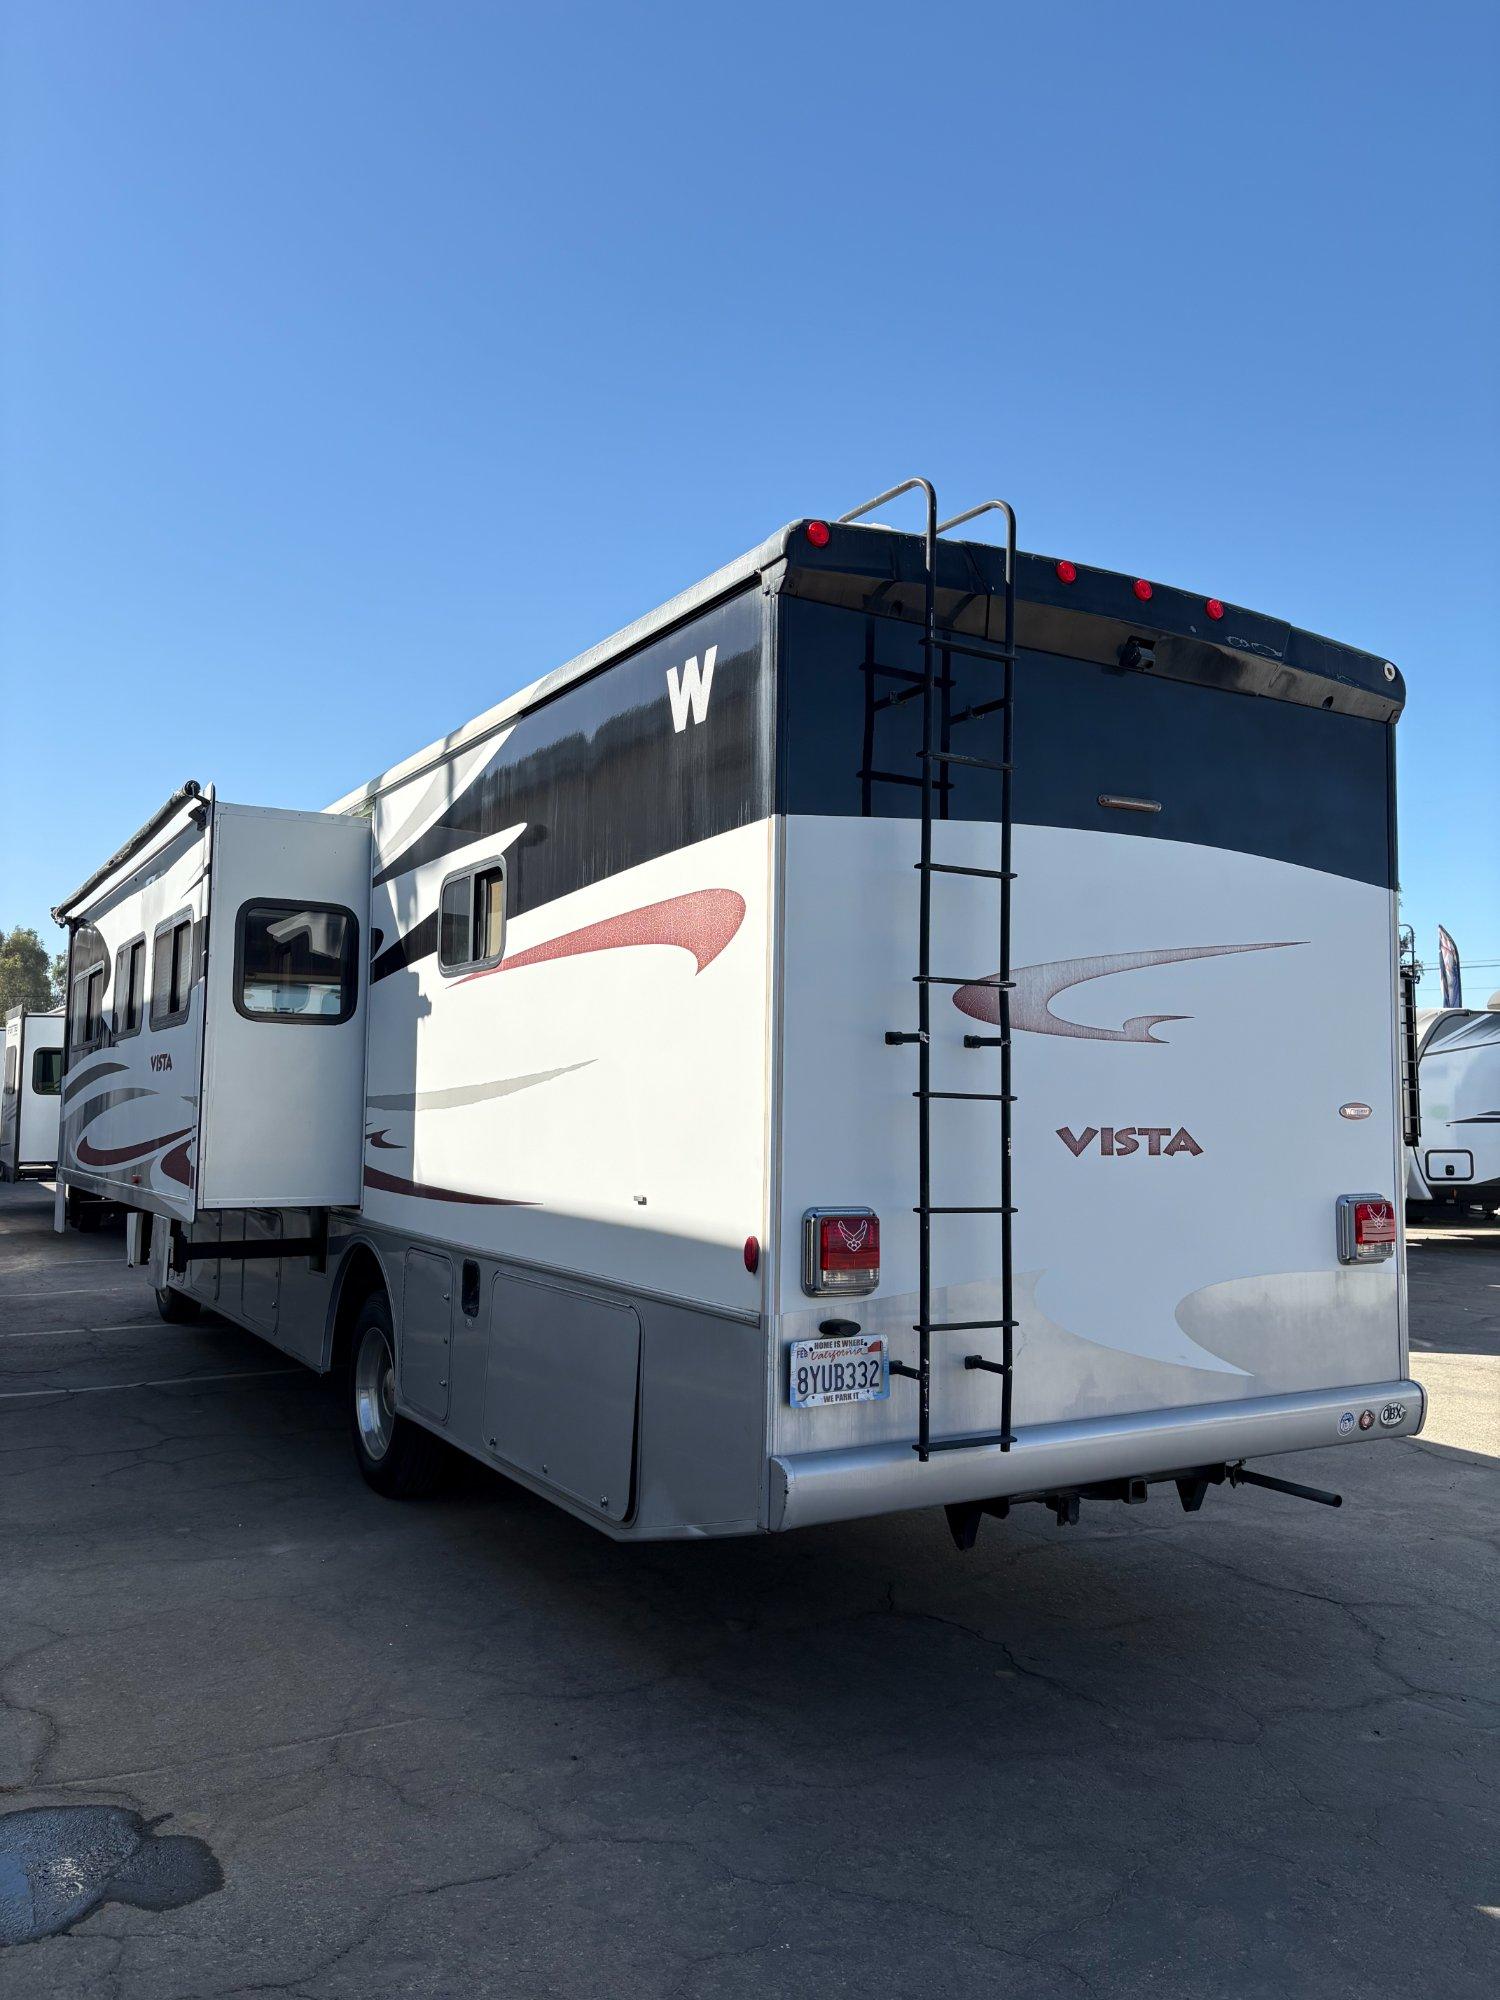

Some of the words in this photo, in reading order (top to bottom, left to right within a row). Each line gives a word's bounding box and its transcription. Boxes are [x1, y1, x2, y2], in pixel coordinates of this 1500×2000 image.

[666, 644, 719, 734] W
[150, 1053, 173, 1072] VISTA
[1055, 1126, 1205, 1158] VISTA
[814, 1341, 833, 1350] HOME
[834, 1340, 841, 1349] IS
[842, 1339, 864, 1348] WHERE
[810, 1347, 863, 1362] California
[797, 1360, 879, 1394] 8YUB332
[823, 1395, 834, 1403] WE
[835, 1393, 852, 1402] PARK
[852, 1392, 860, 1400] IT
[1383, 1406, 1402, 1421] OBX
